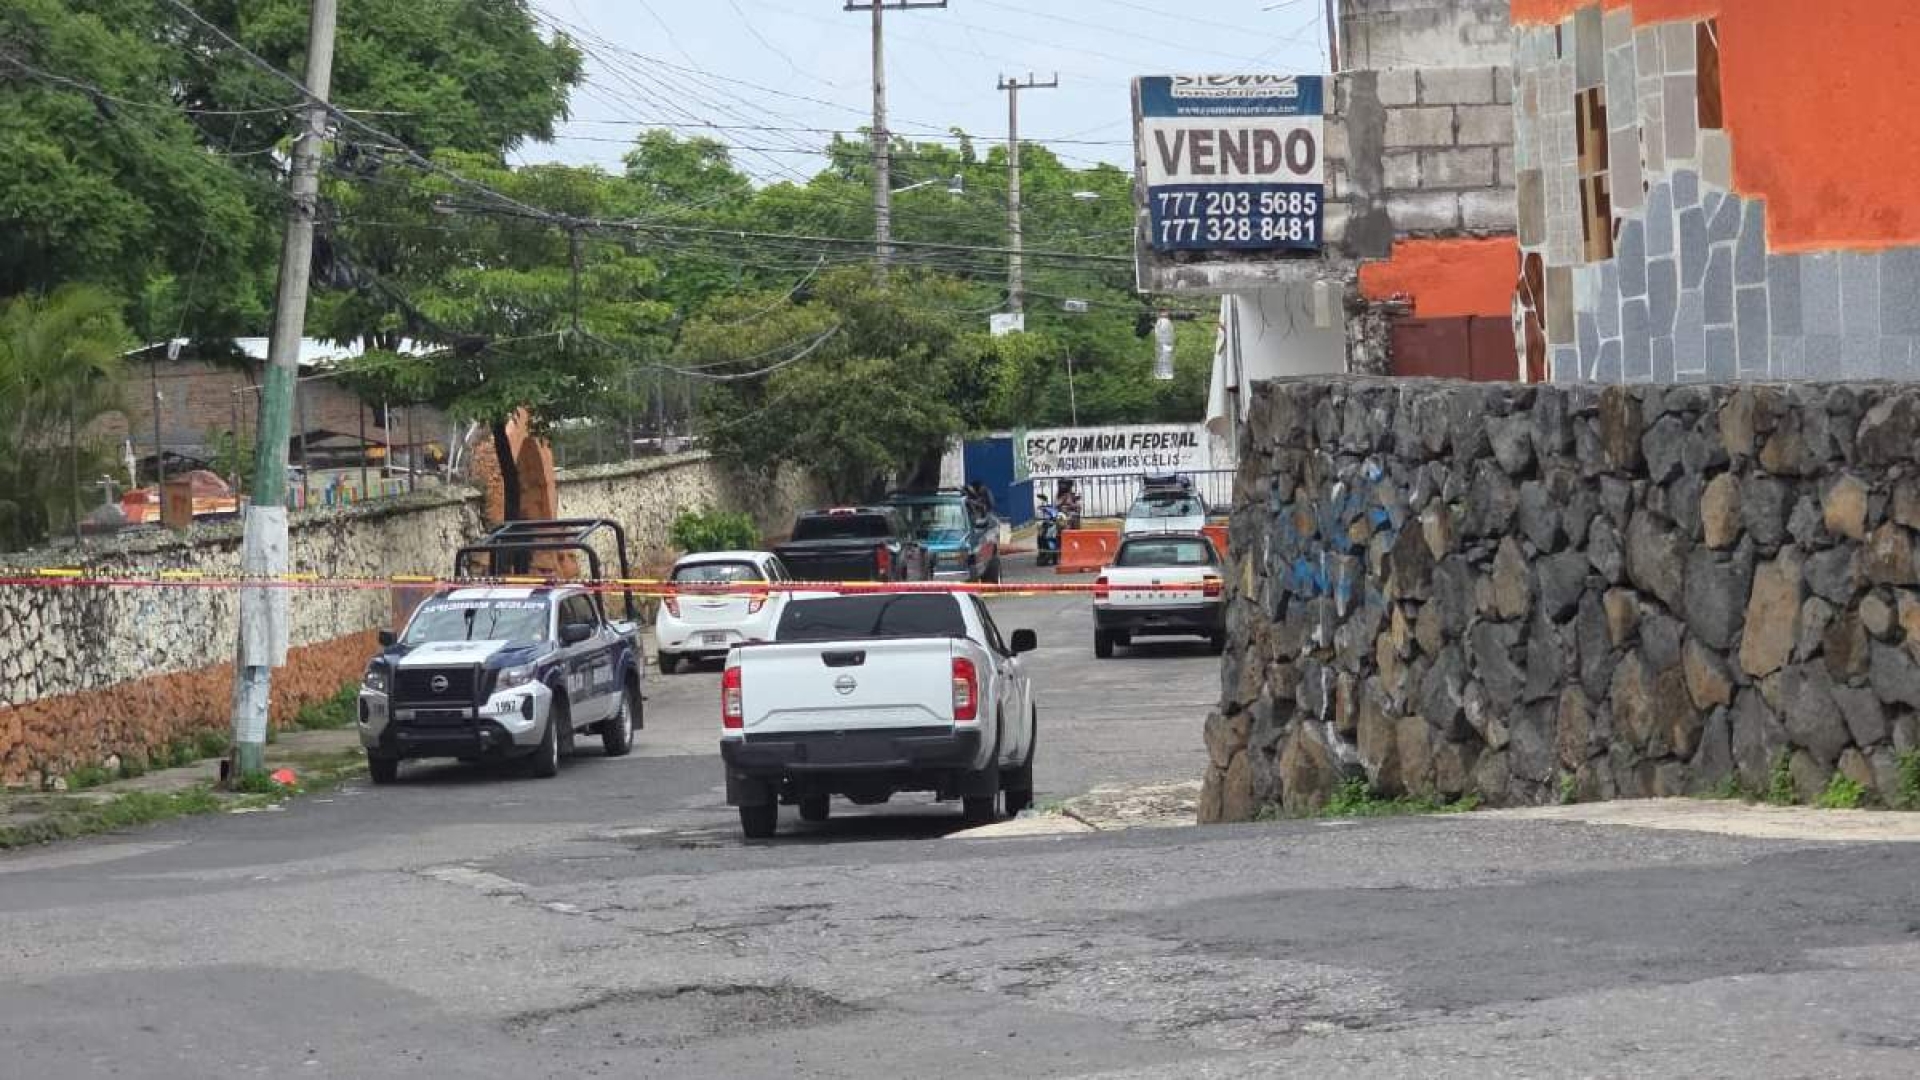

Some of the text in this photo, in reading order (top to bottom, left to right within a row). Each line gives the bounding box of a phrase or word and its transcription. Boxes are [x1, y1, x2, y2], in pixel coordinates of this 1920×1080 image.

[1154, 128, 1316, 176] VENDO
[1158, 191, 1317, 216] 777 203 5685
[1160, 216, 1315, 243] 777 328 8481
[1059, 432, 1126, 454] PRIMARIA
[1131, 431, 1198, 451] FEDERAL
